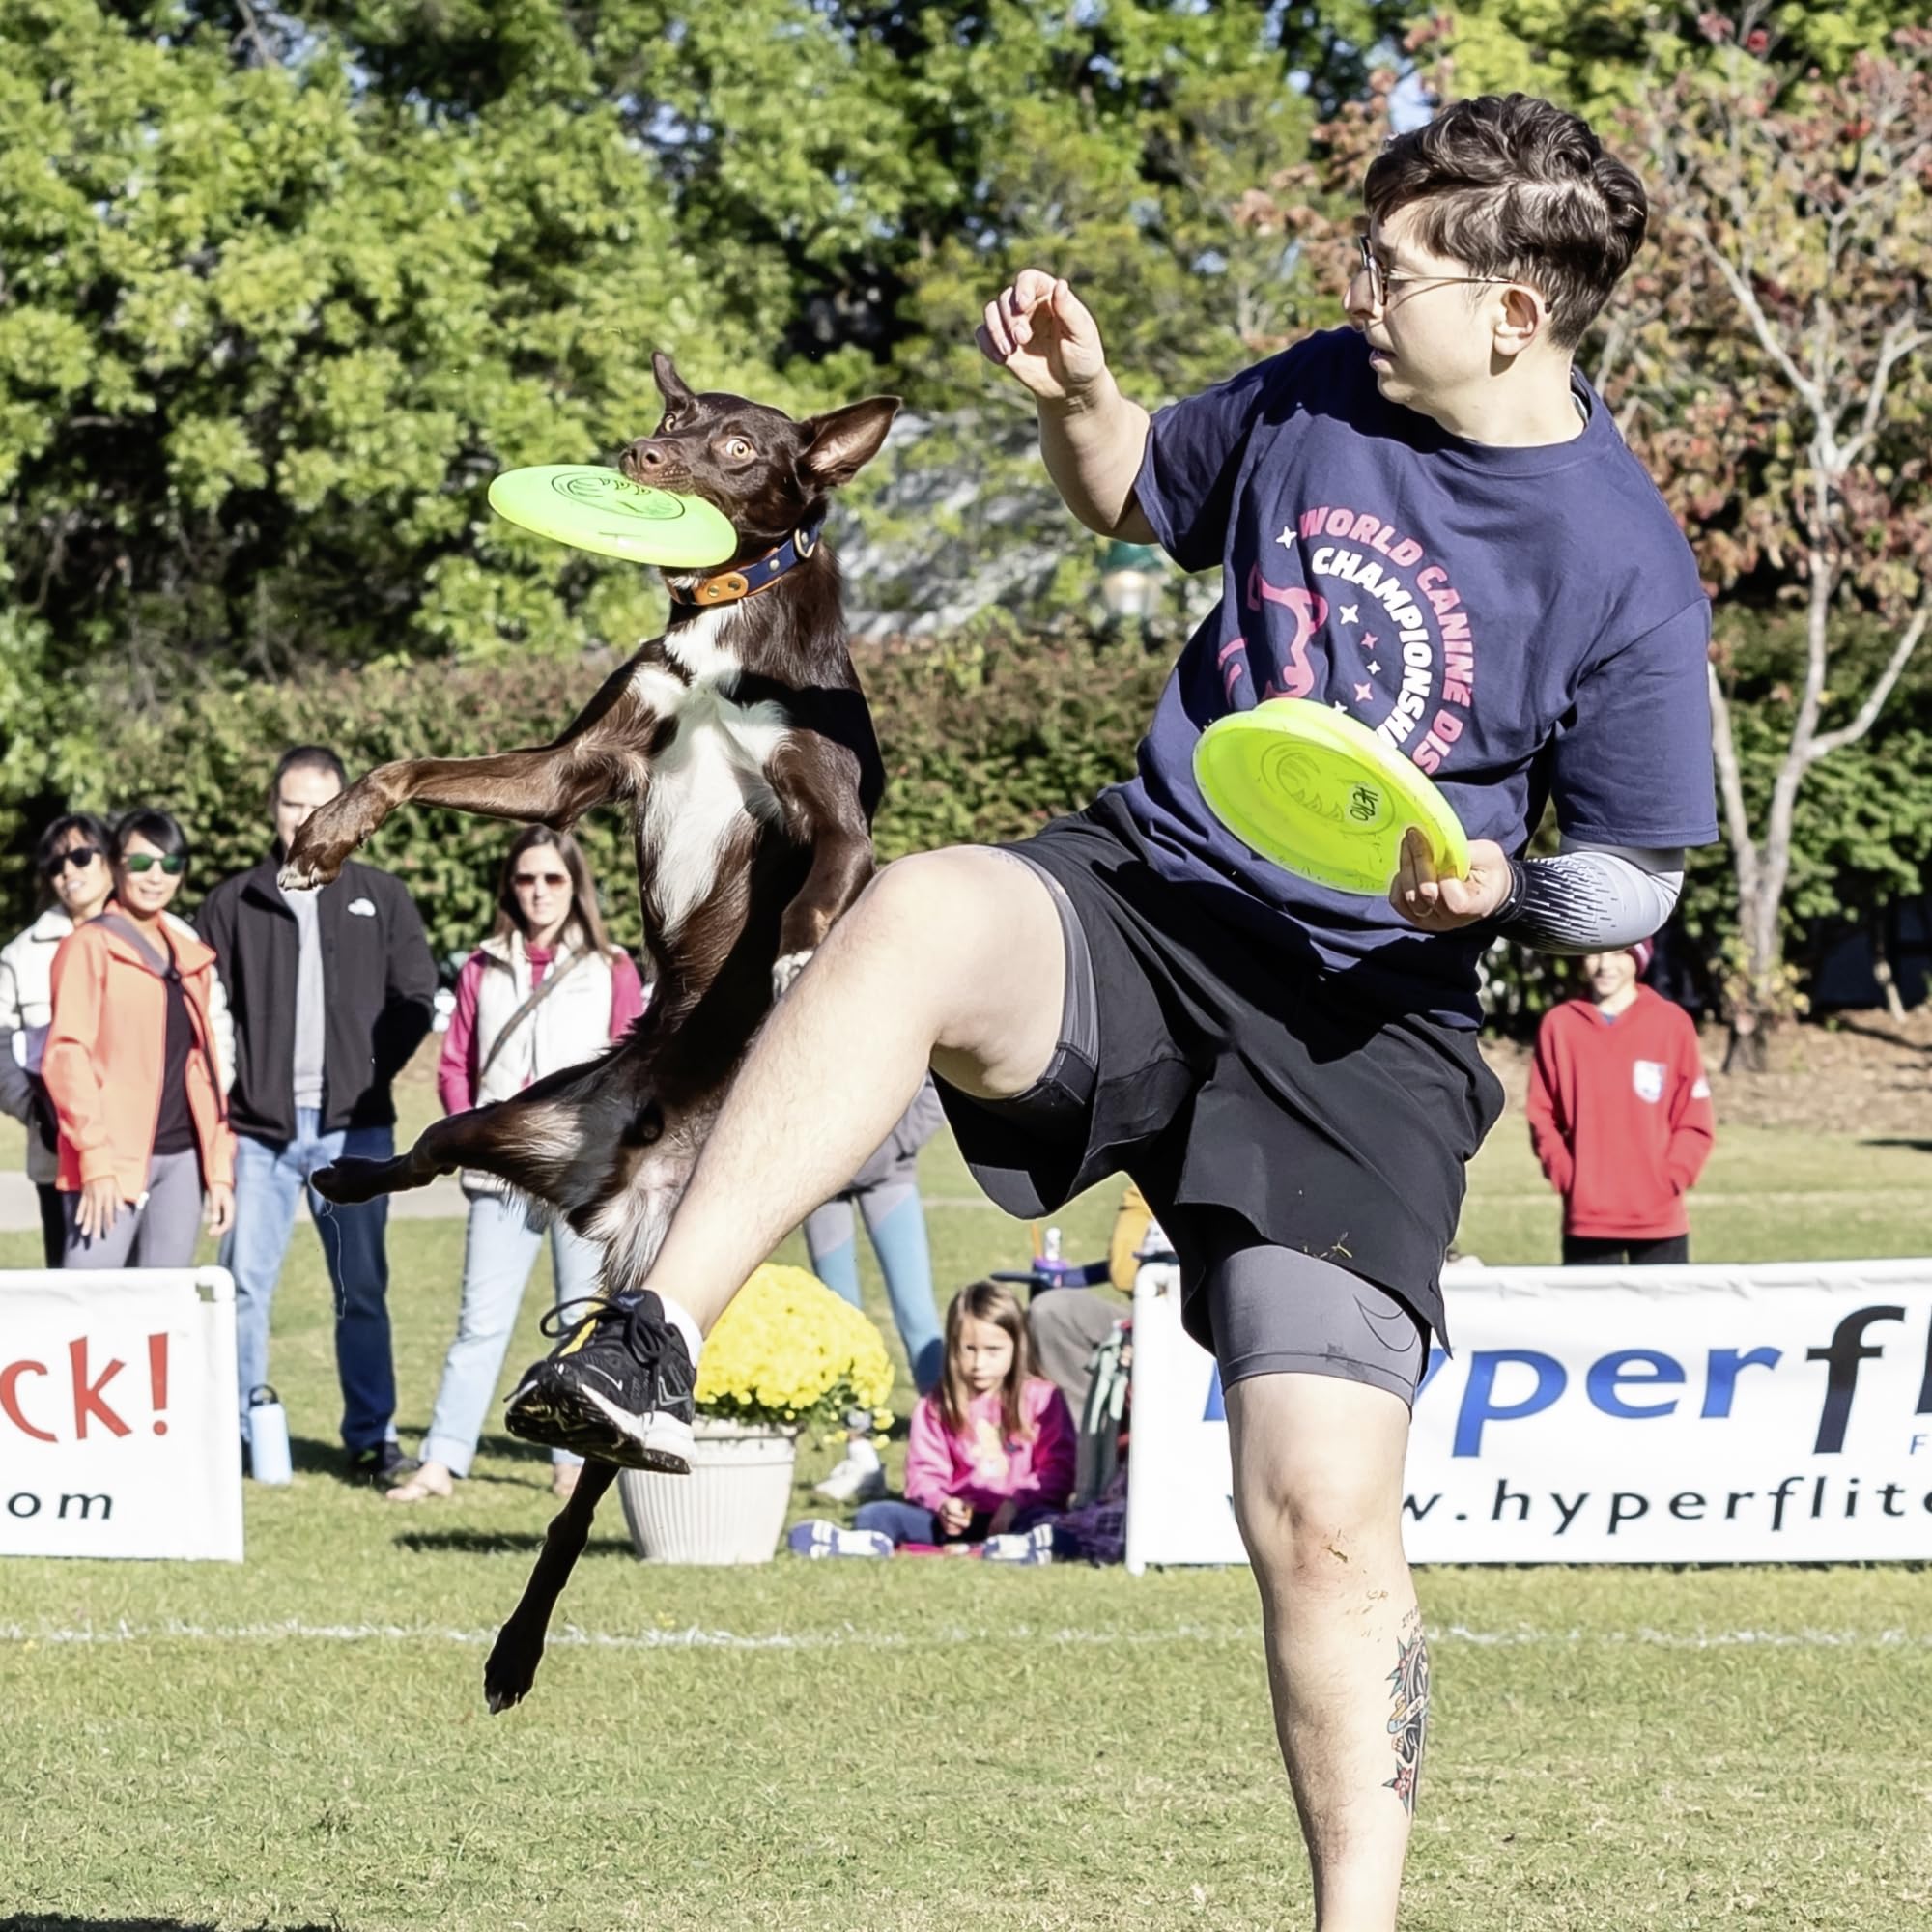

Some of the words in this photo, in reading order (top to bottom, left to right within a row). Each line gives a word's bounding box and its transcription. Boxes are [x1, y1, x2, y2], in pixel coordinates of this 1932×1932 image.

[1300, 506, 1424, 567] WORLD
[1417, 565, 1474, 708] CANINE
[1350, 786, 1378, 821] HERO
[0, 1332, 168, 1443] ck!
[1203, 1302, 1932, 1457] perf
[8, 1492, 113, 1520] om
[1226, 1474, 1932, 1537] w.hyperflit
